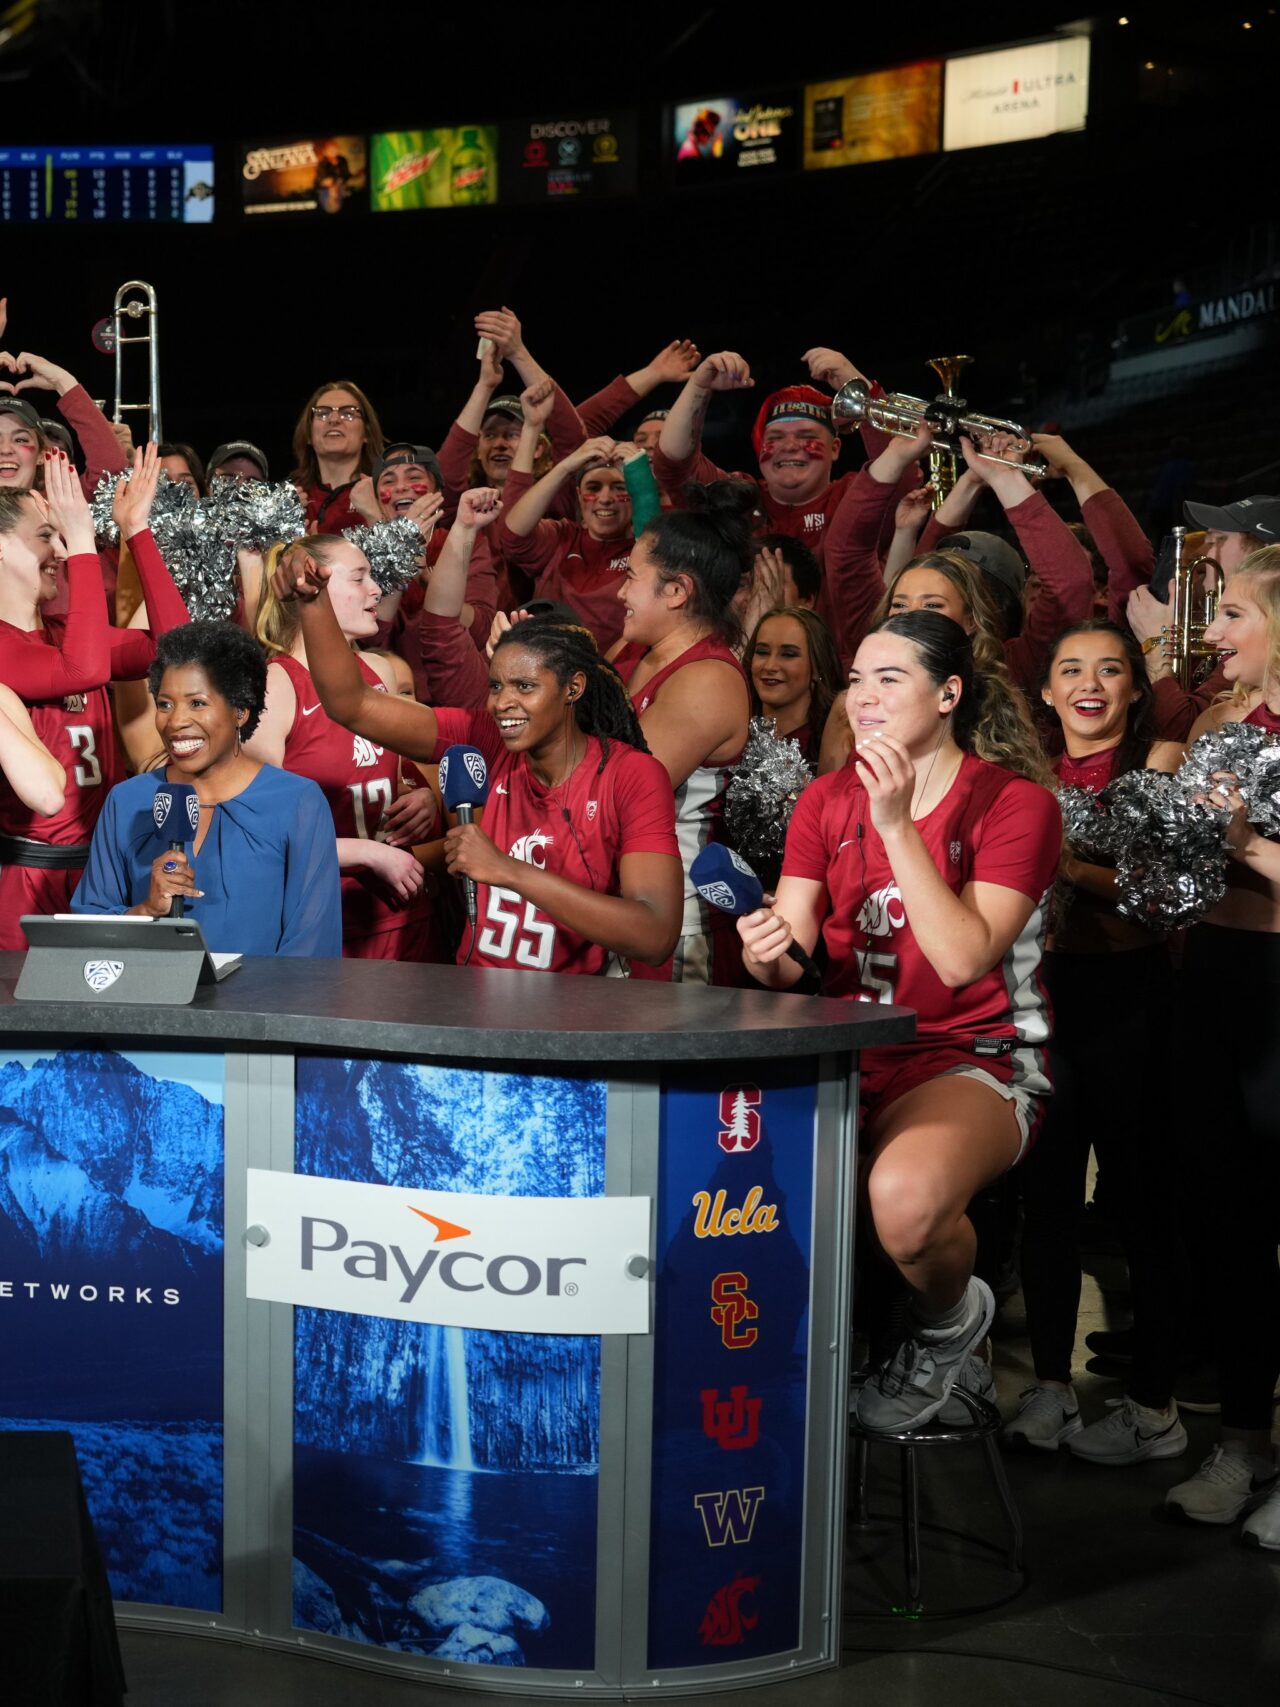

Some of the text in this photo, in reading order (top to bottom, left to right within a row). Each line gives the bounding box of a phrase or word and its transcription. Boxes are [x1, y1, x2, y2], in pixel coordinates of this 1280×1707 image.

[1022, 72, 1076, 93] ULTRA
[991, 97, 1040, 115] ARENA
[531, 119, 609, 139] DISCOVER
[65, 724, 102, 788] 3
[478, 886, 557, 971] 55
[93, 976, 108, 985] 12
[694, 1487, 765, 1548] W
